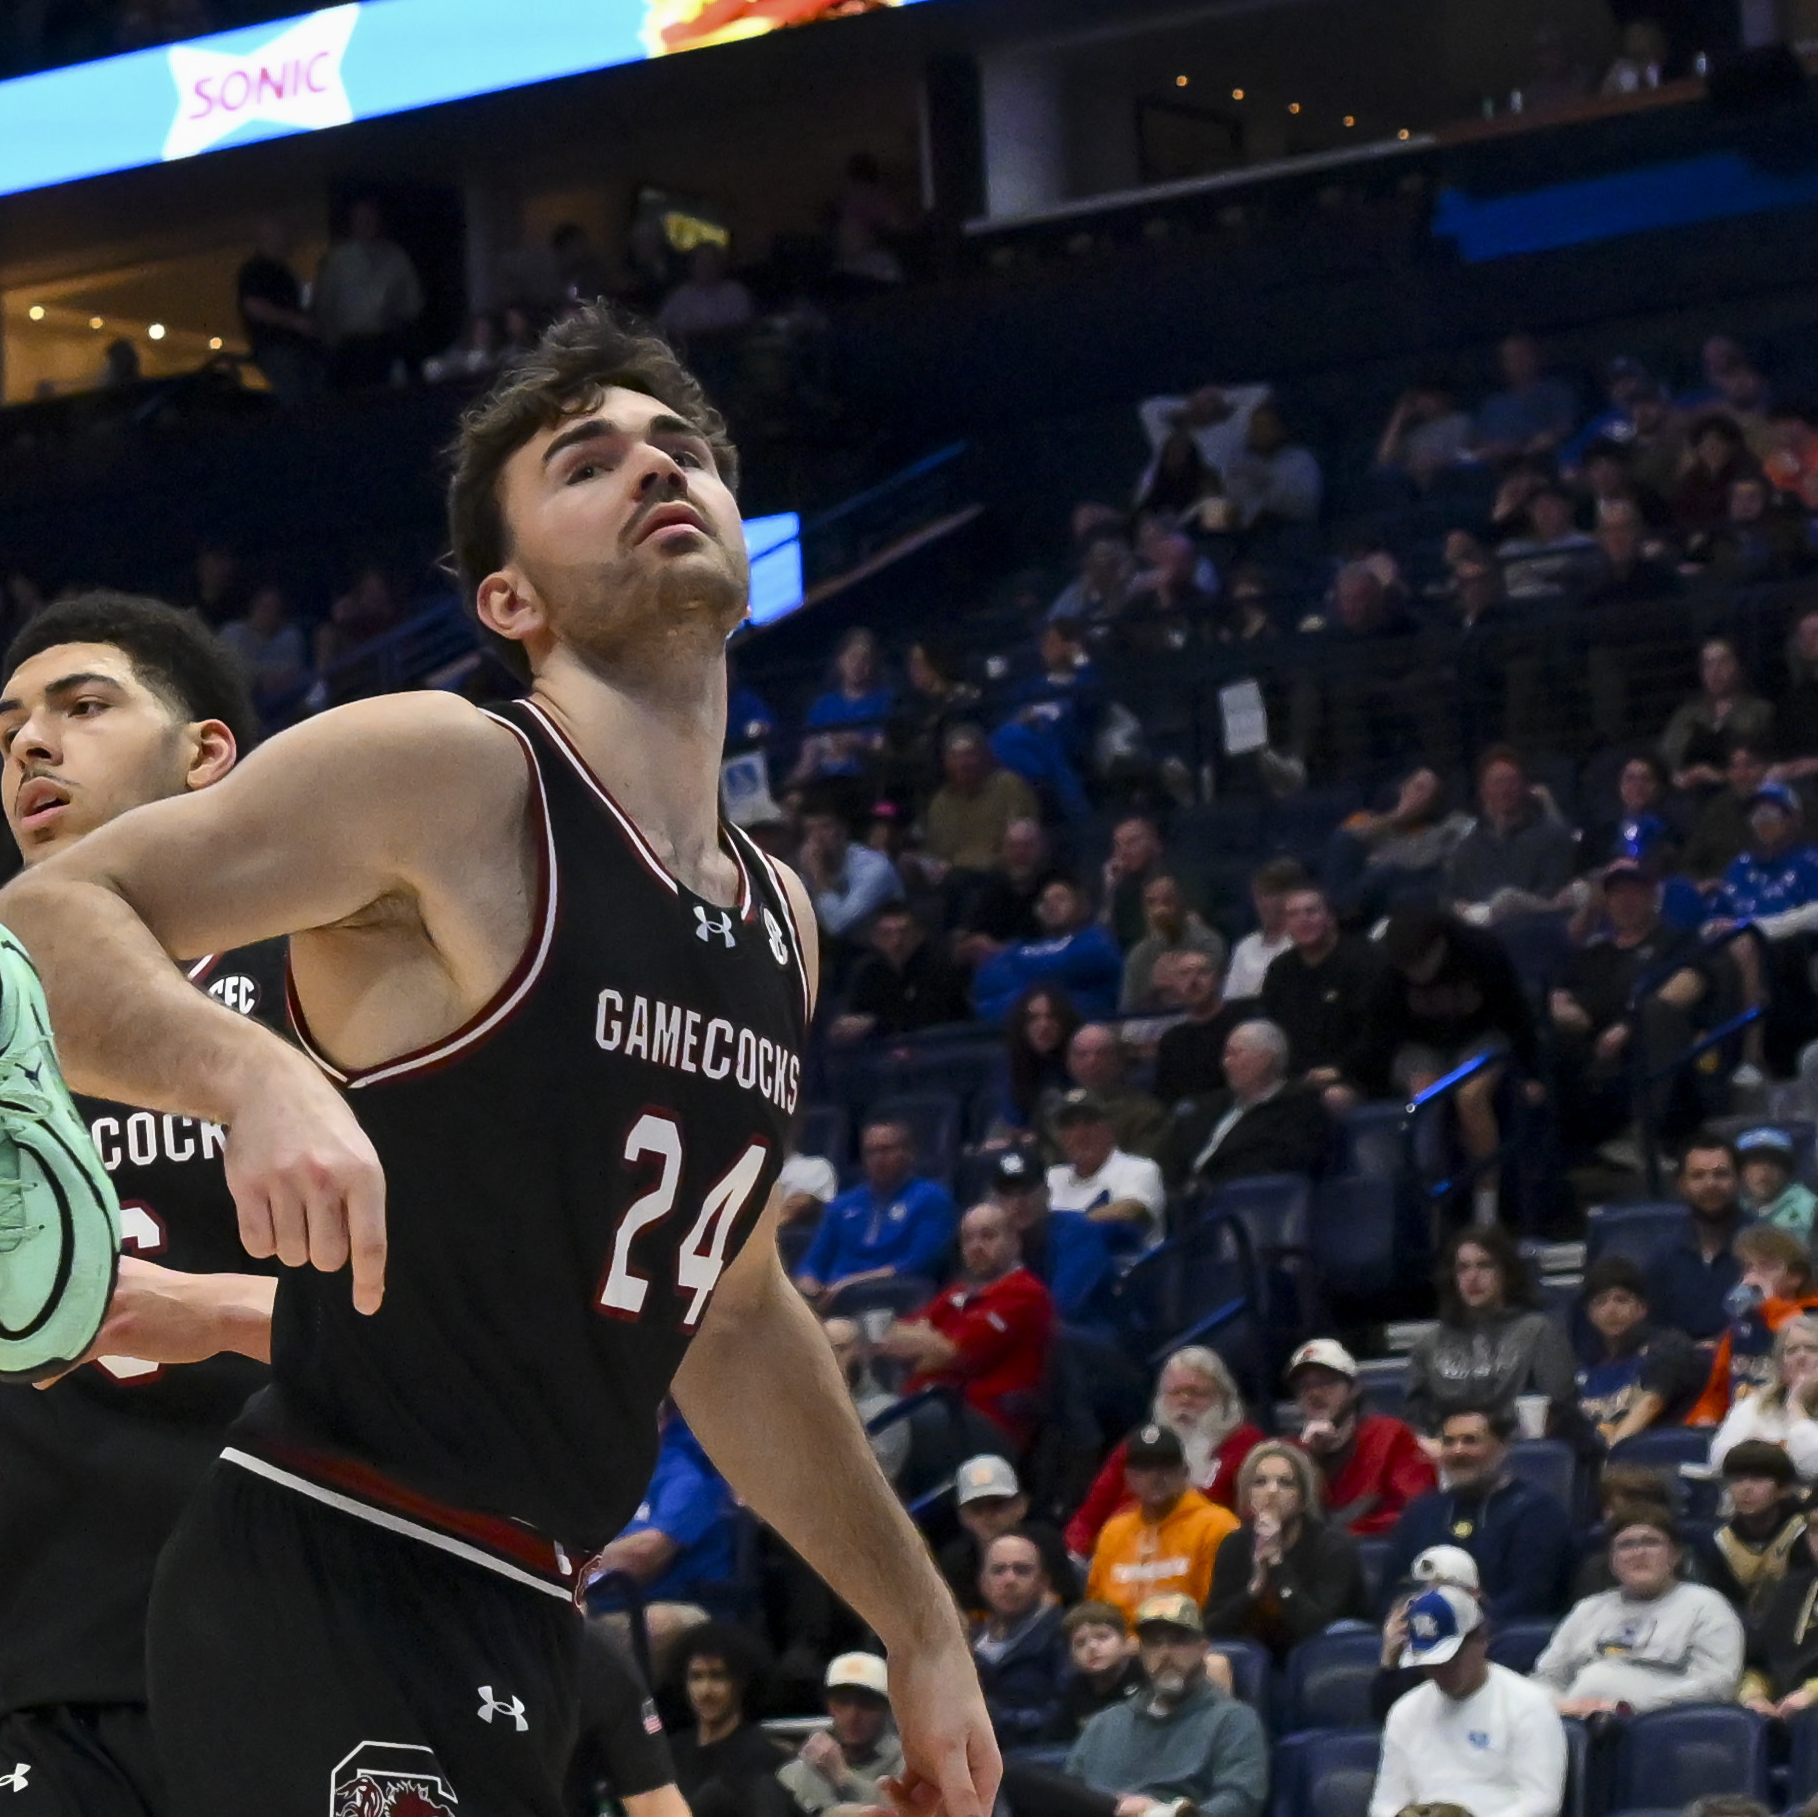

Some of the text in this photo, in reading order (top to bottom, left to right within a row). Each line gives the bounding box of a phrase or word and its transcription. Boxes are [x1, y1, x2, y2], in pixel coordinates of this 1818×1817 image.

[189, 51, 330, 120] SONIC
[595, 987, 801, 1116] GAMECOCKS
[599, 1111, 768, 1329] 24
